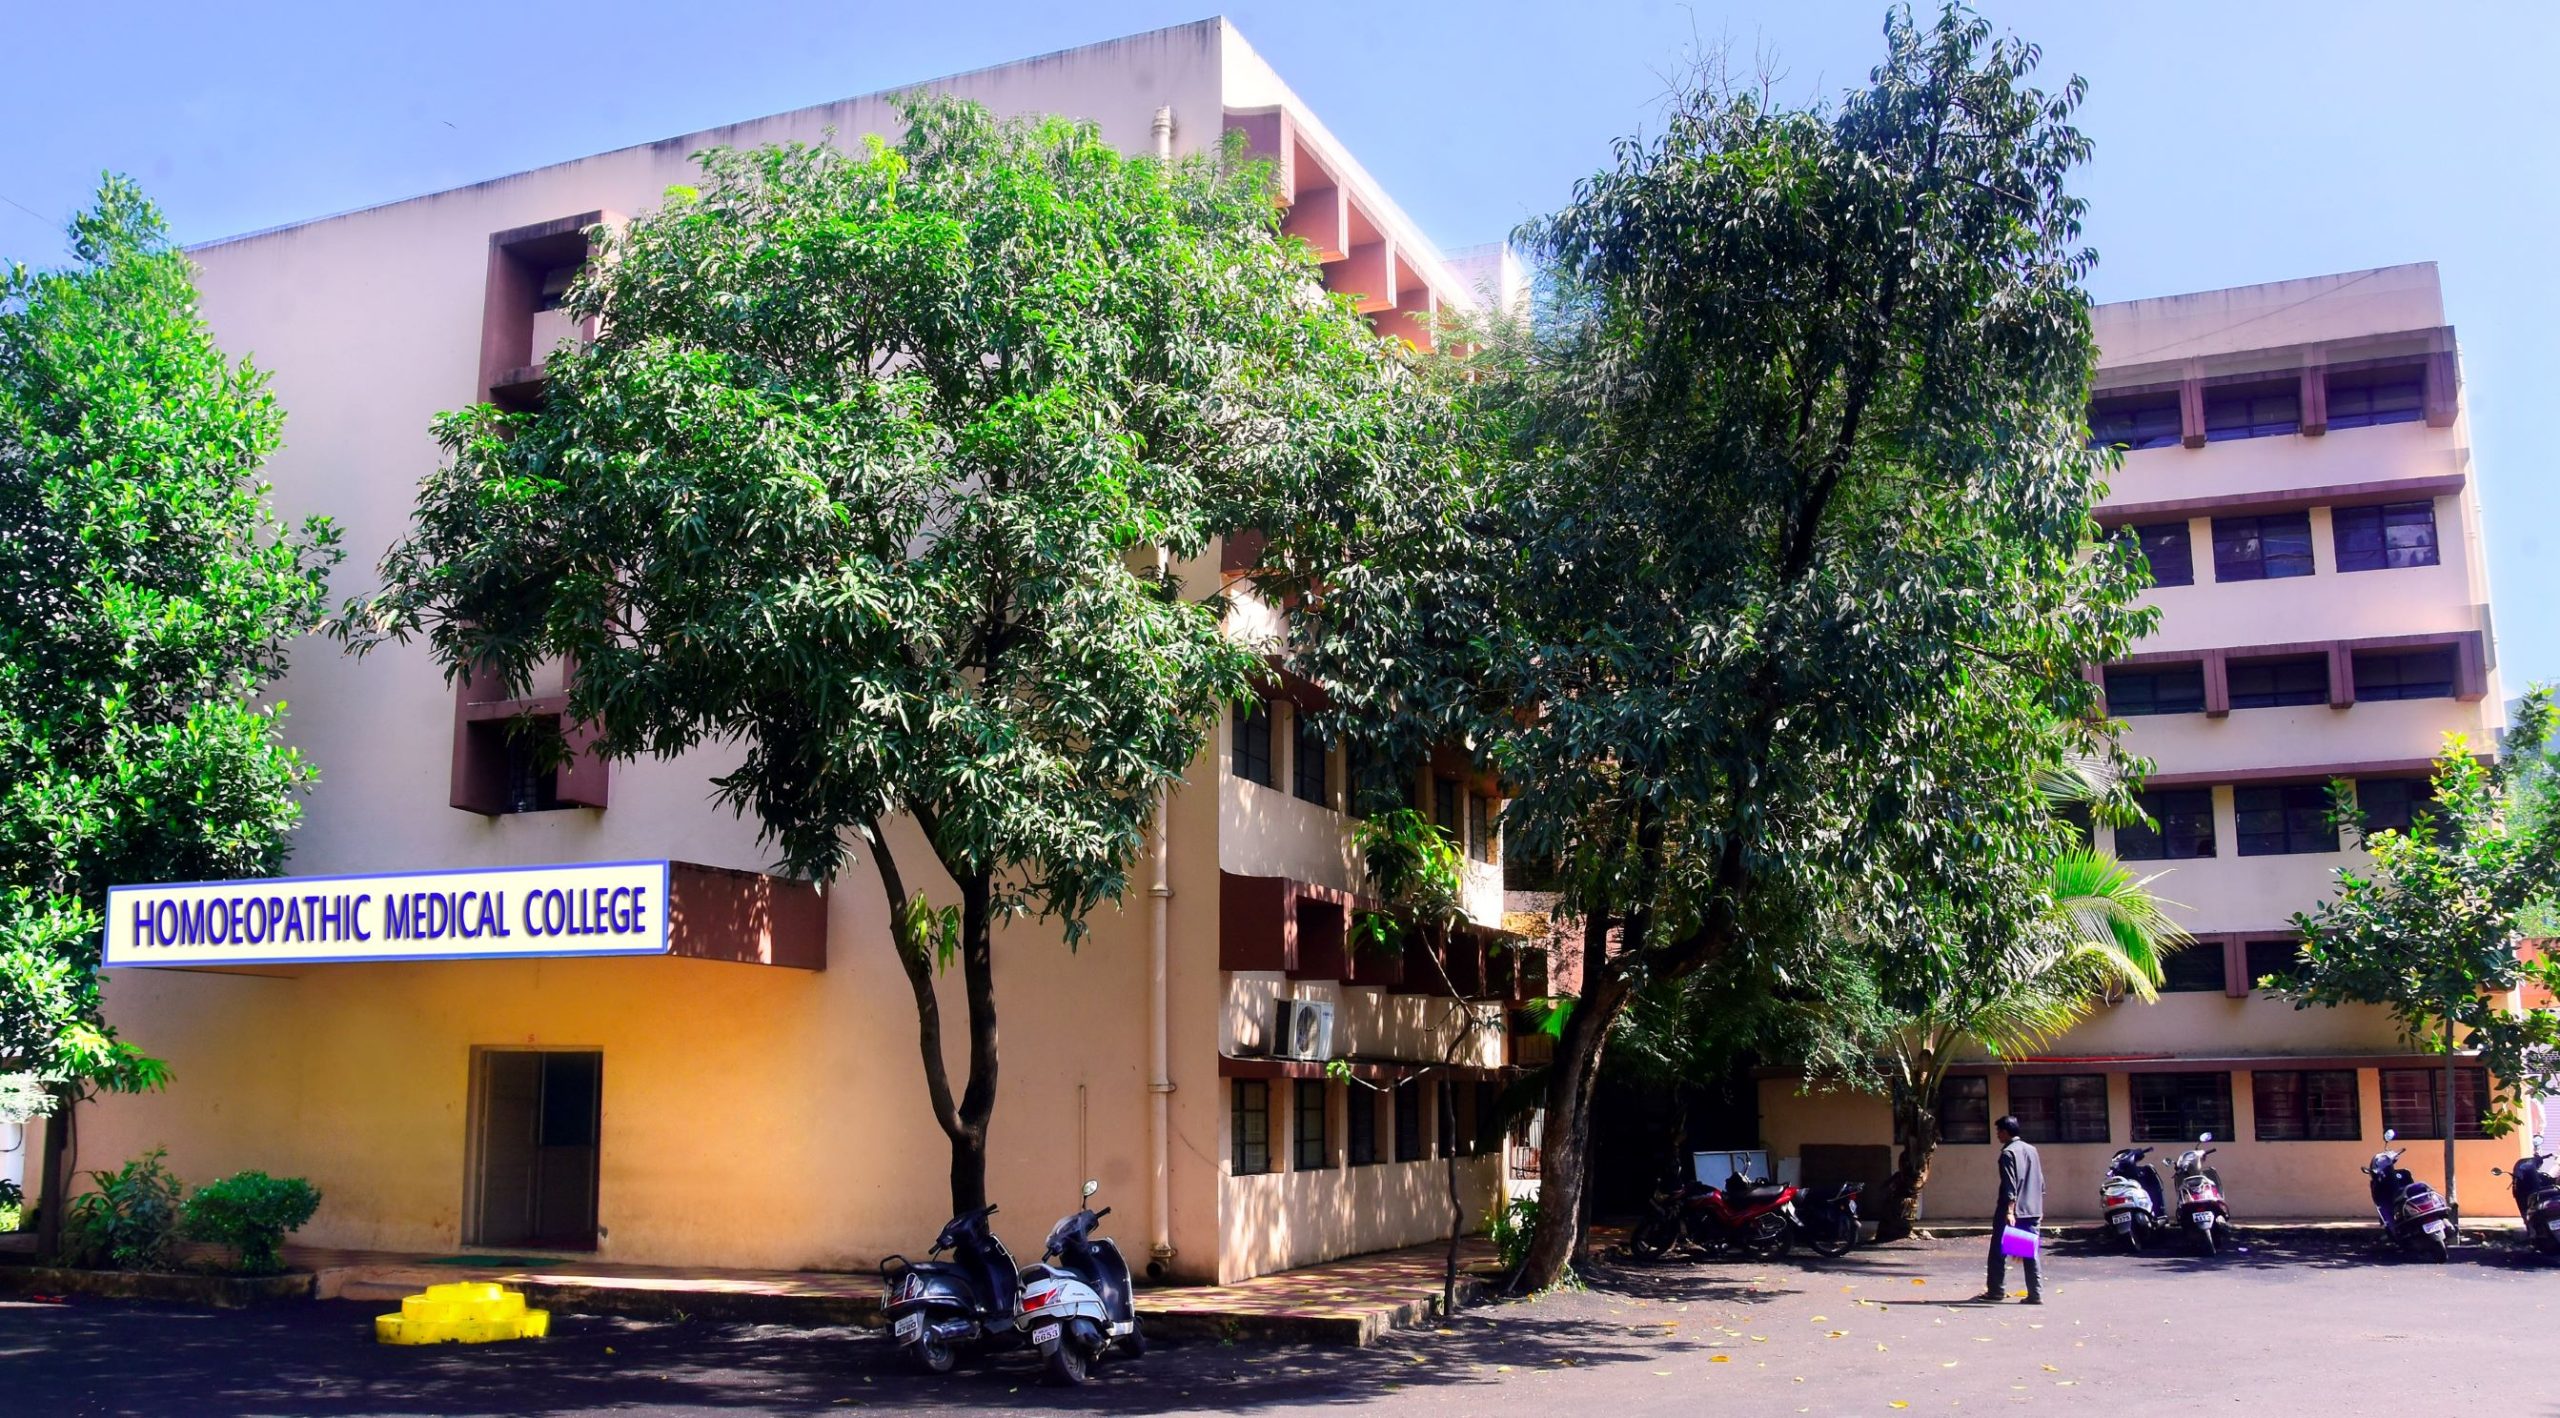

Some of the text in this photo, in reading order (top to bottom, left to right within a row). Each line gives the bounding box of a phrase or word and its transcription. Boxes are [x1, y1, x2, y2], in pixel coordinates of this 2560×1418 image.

[133, 886, 646, 946] HOMOEOPATHIC MEDICAL COLLEGE
